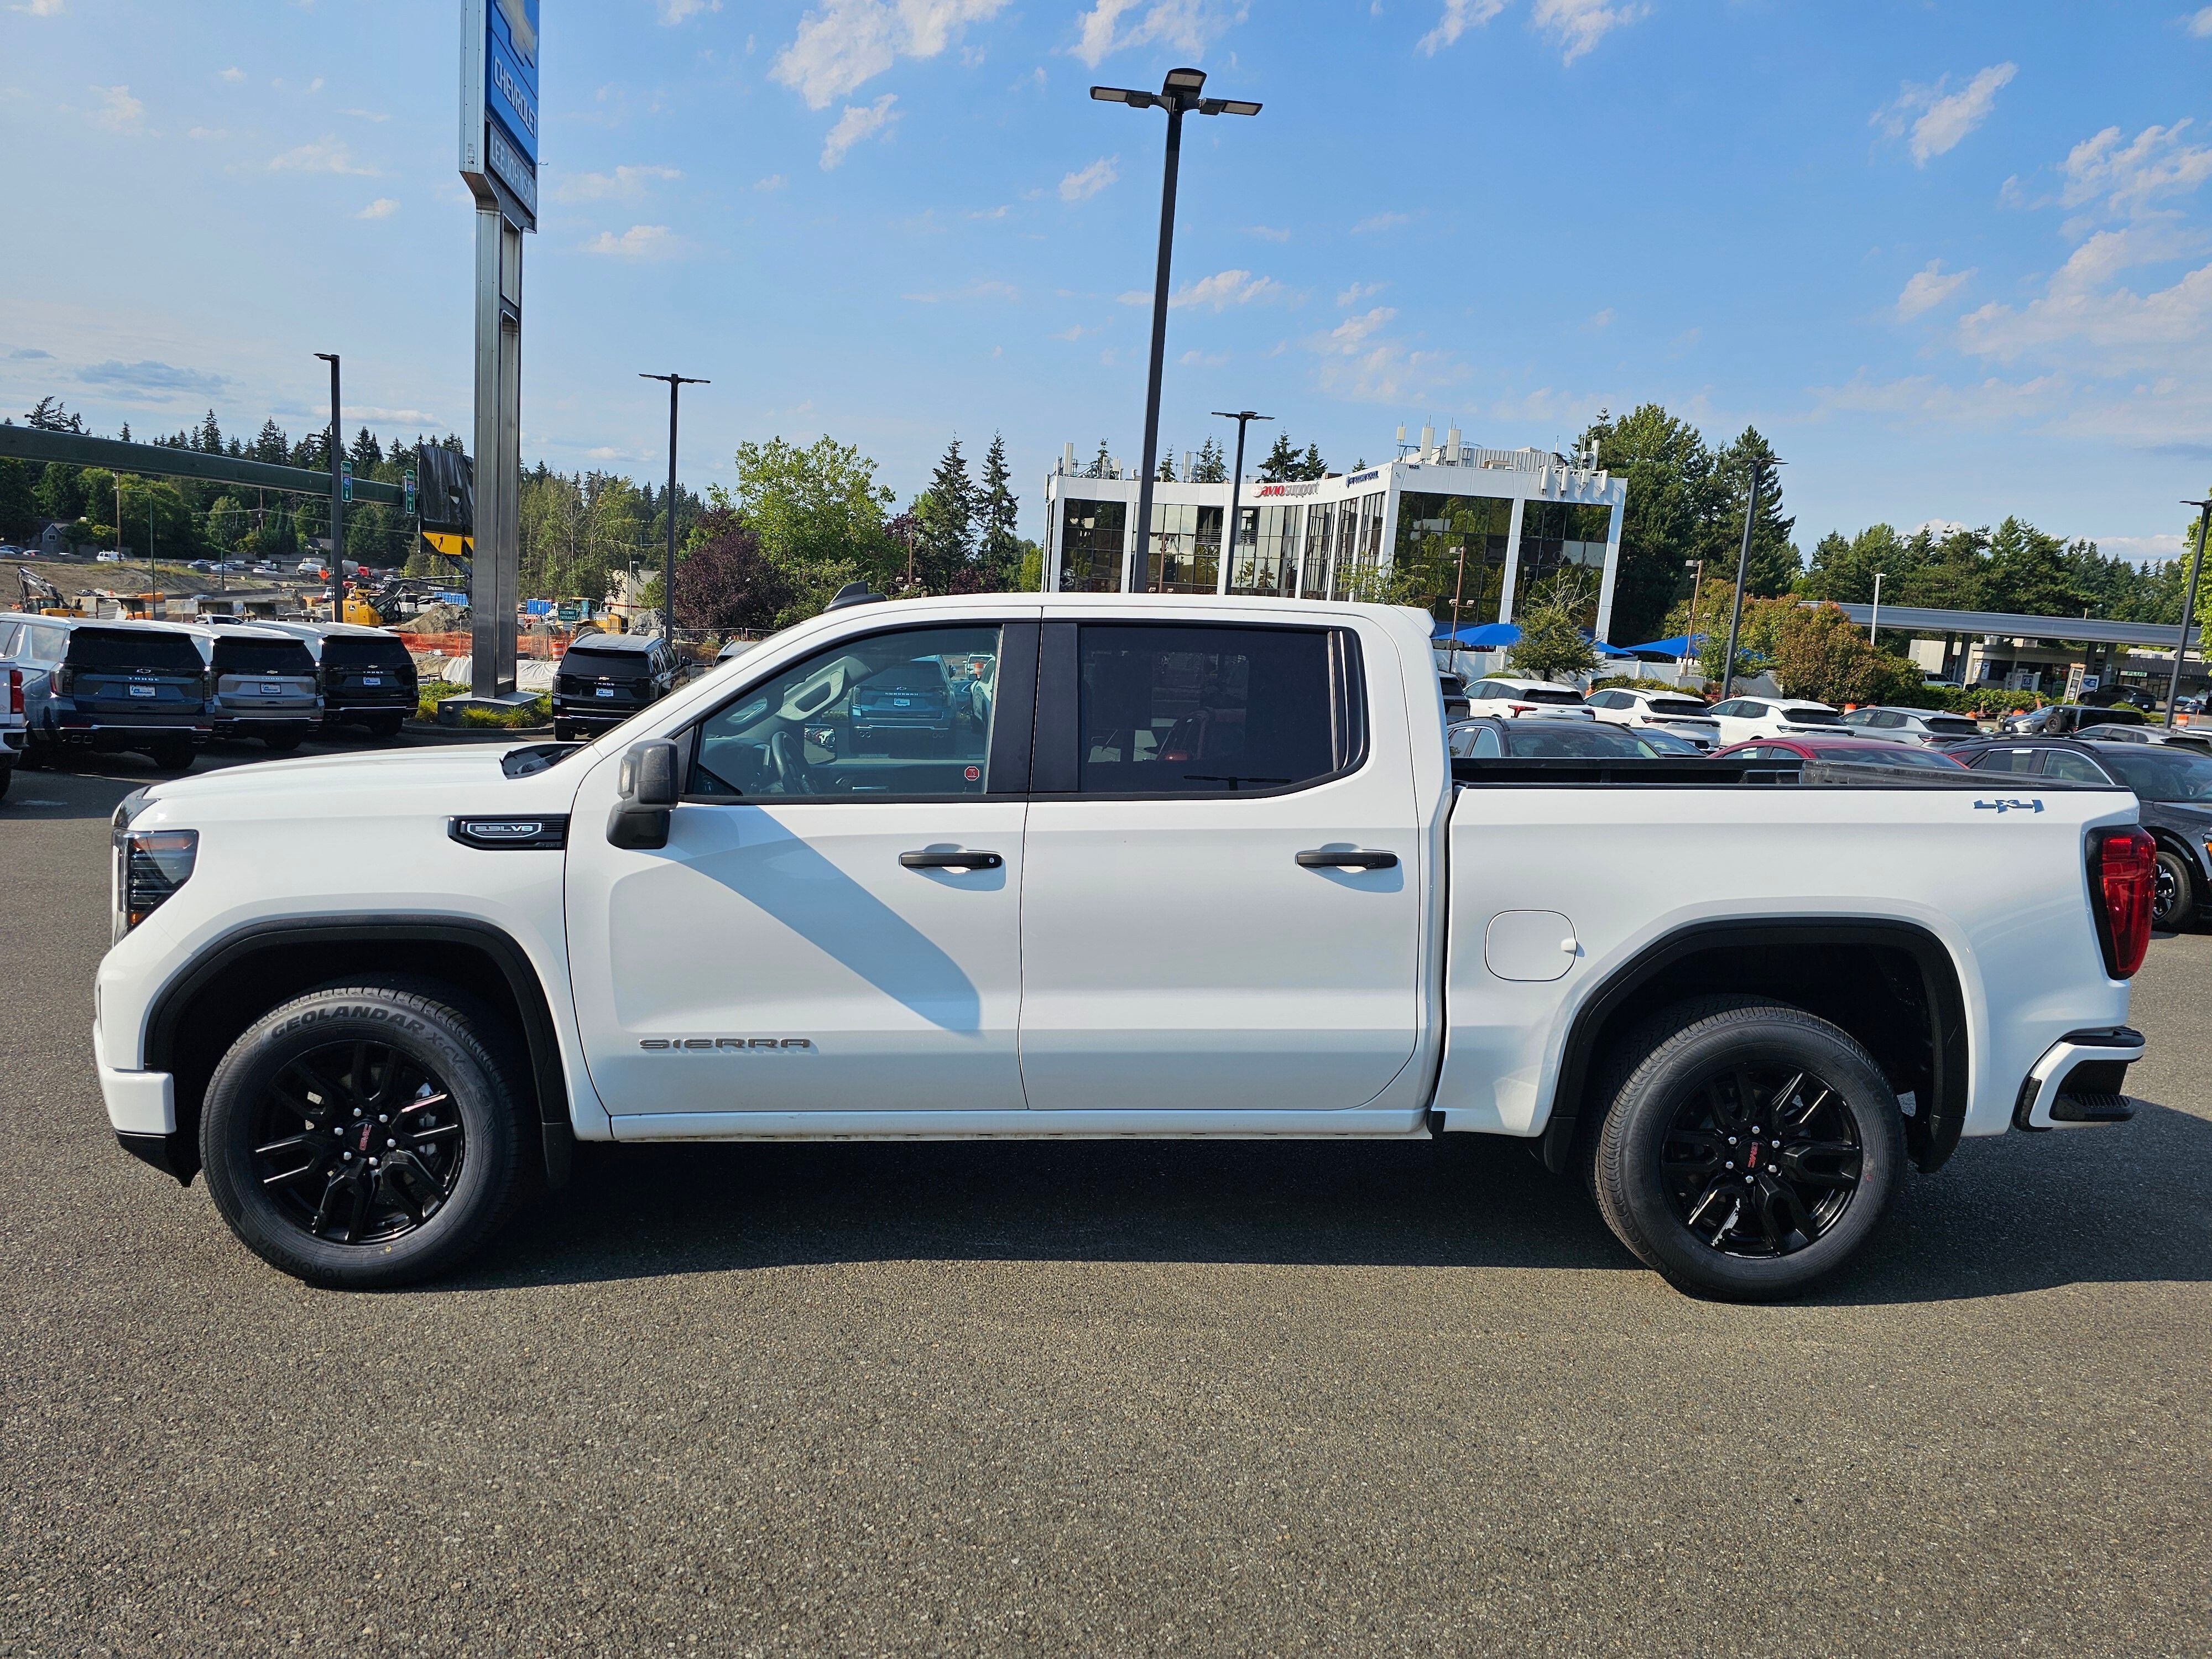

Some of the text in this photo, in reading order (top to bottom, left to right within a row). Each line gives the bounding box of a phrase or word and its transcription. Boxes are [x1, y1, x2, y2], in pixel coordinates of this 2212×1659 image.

[494, 56, 537, 139] CHEVROLET
[491, 133, 536, 209] LEE JOHNSON
[271, 1005, 426, 1039] GEOLANDAR
[639, 1037, 811, 1049] SIERRA
[359, 1123, 372, 1151] GMC
[1747, 1141, 1759, 1168] GMC
